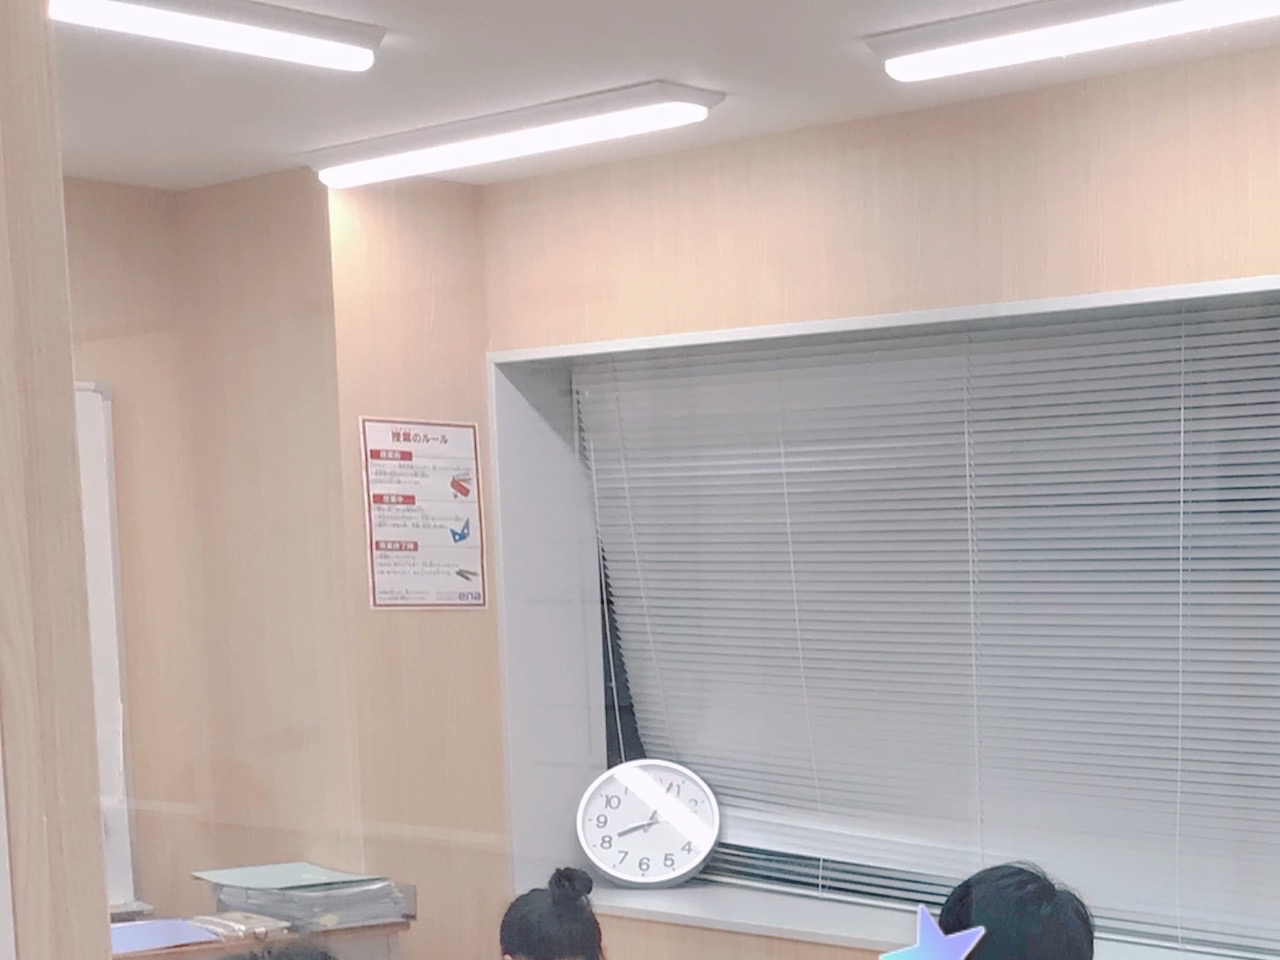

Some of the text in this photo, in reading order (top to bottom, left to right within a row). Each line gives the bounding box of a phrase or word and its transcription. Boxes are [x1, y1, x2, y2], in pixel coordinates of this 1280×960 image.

[392, 431, 449, 444] 授業のルール
[458, 591, 482, 601] ena
[604, 794, 621, 810] 10
[595, 813, 608, 829] 9
[600, 835, 613, 850] 8
[681, 840, 693, 855] 4
[617, 850, 629, 865] 7
[638, 857, 650, 872] 6
[663, 852, 675, 868] 5
